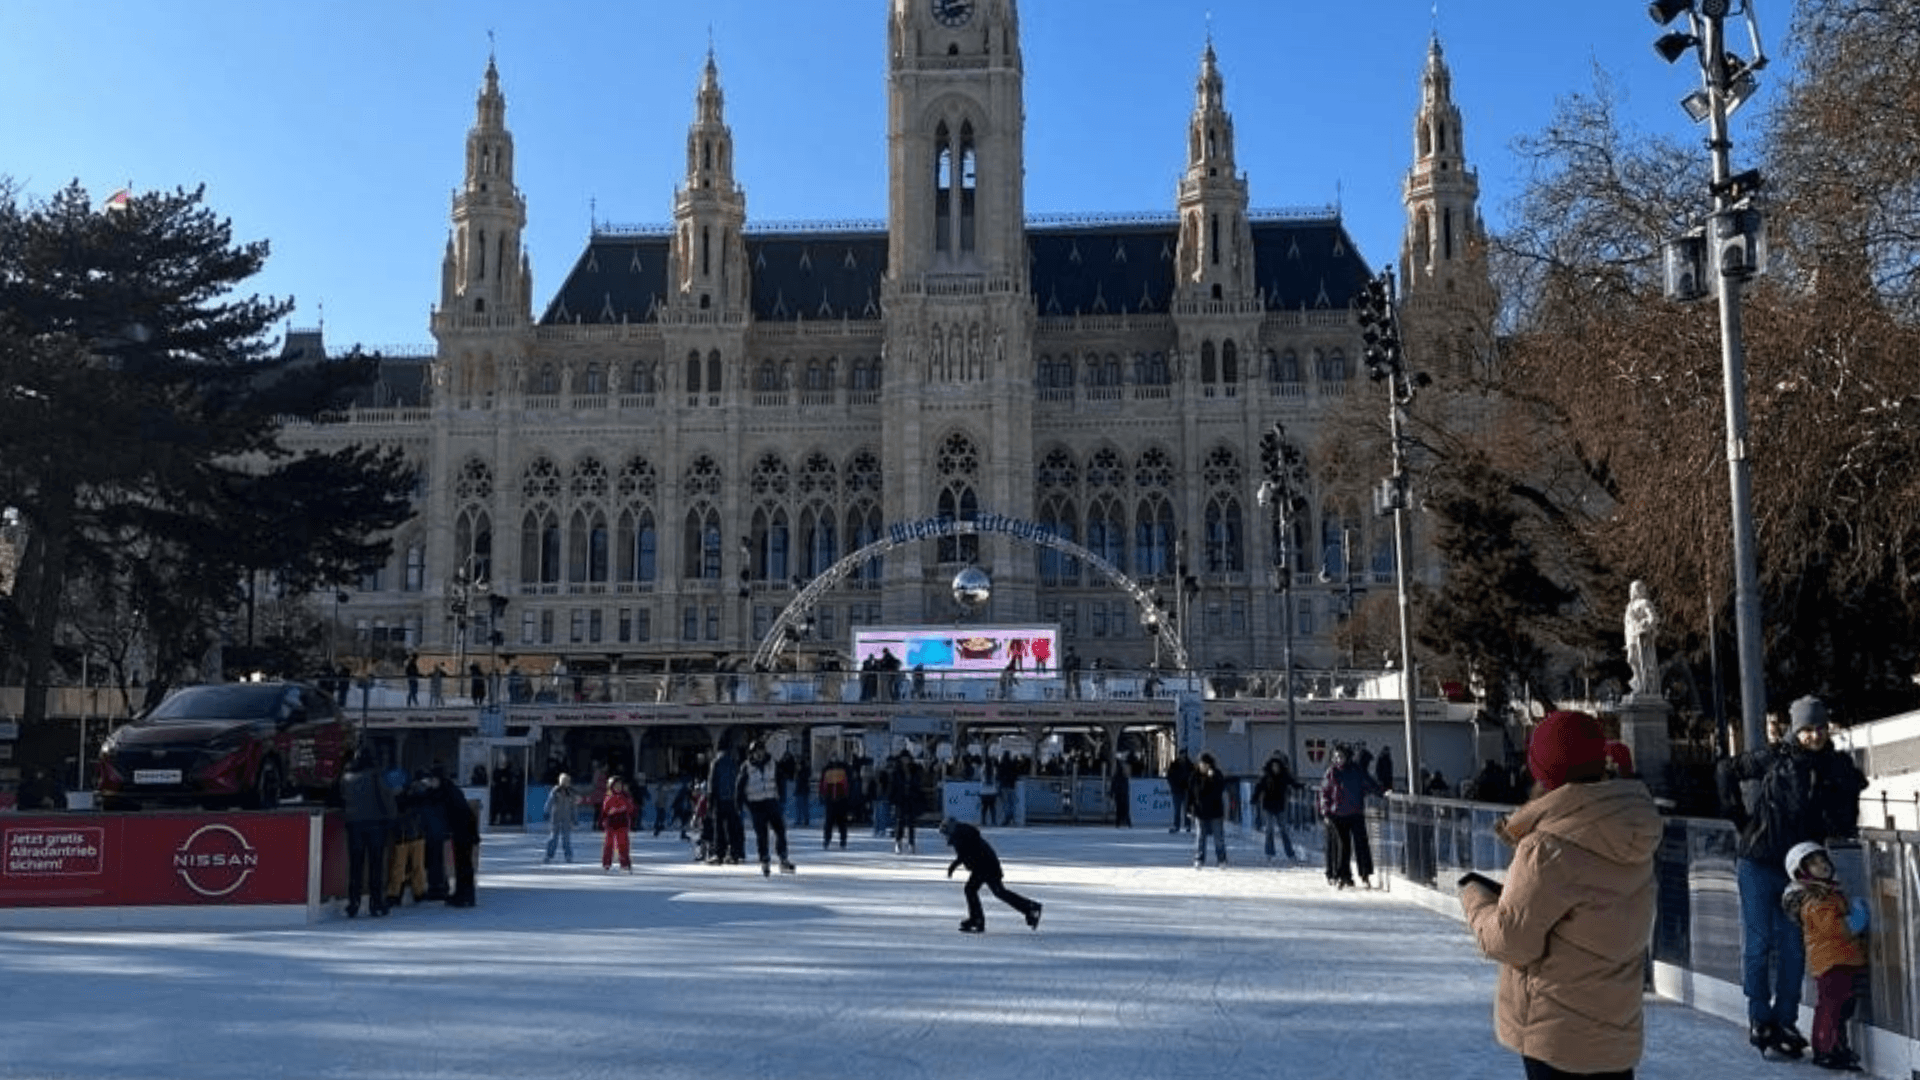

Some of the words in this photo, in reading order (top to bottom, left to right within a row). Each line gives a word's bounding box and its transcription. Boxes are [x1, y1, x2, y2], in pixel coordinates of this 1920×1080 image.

[11, 834, 45, 845] Jetzt
[47, 832, 85, 846] gratis
[10, 845, 98, 857] Allradantrieb
[10, 857, 63, 870] sichern!
[173, 853, 259, 867] NISSAN
